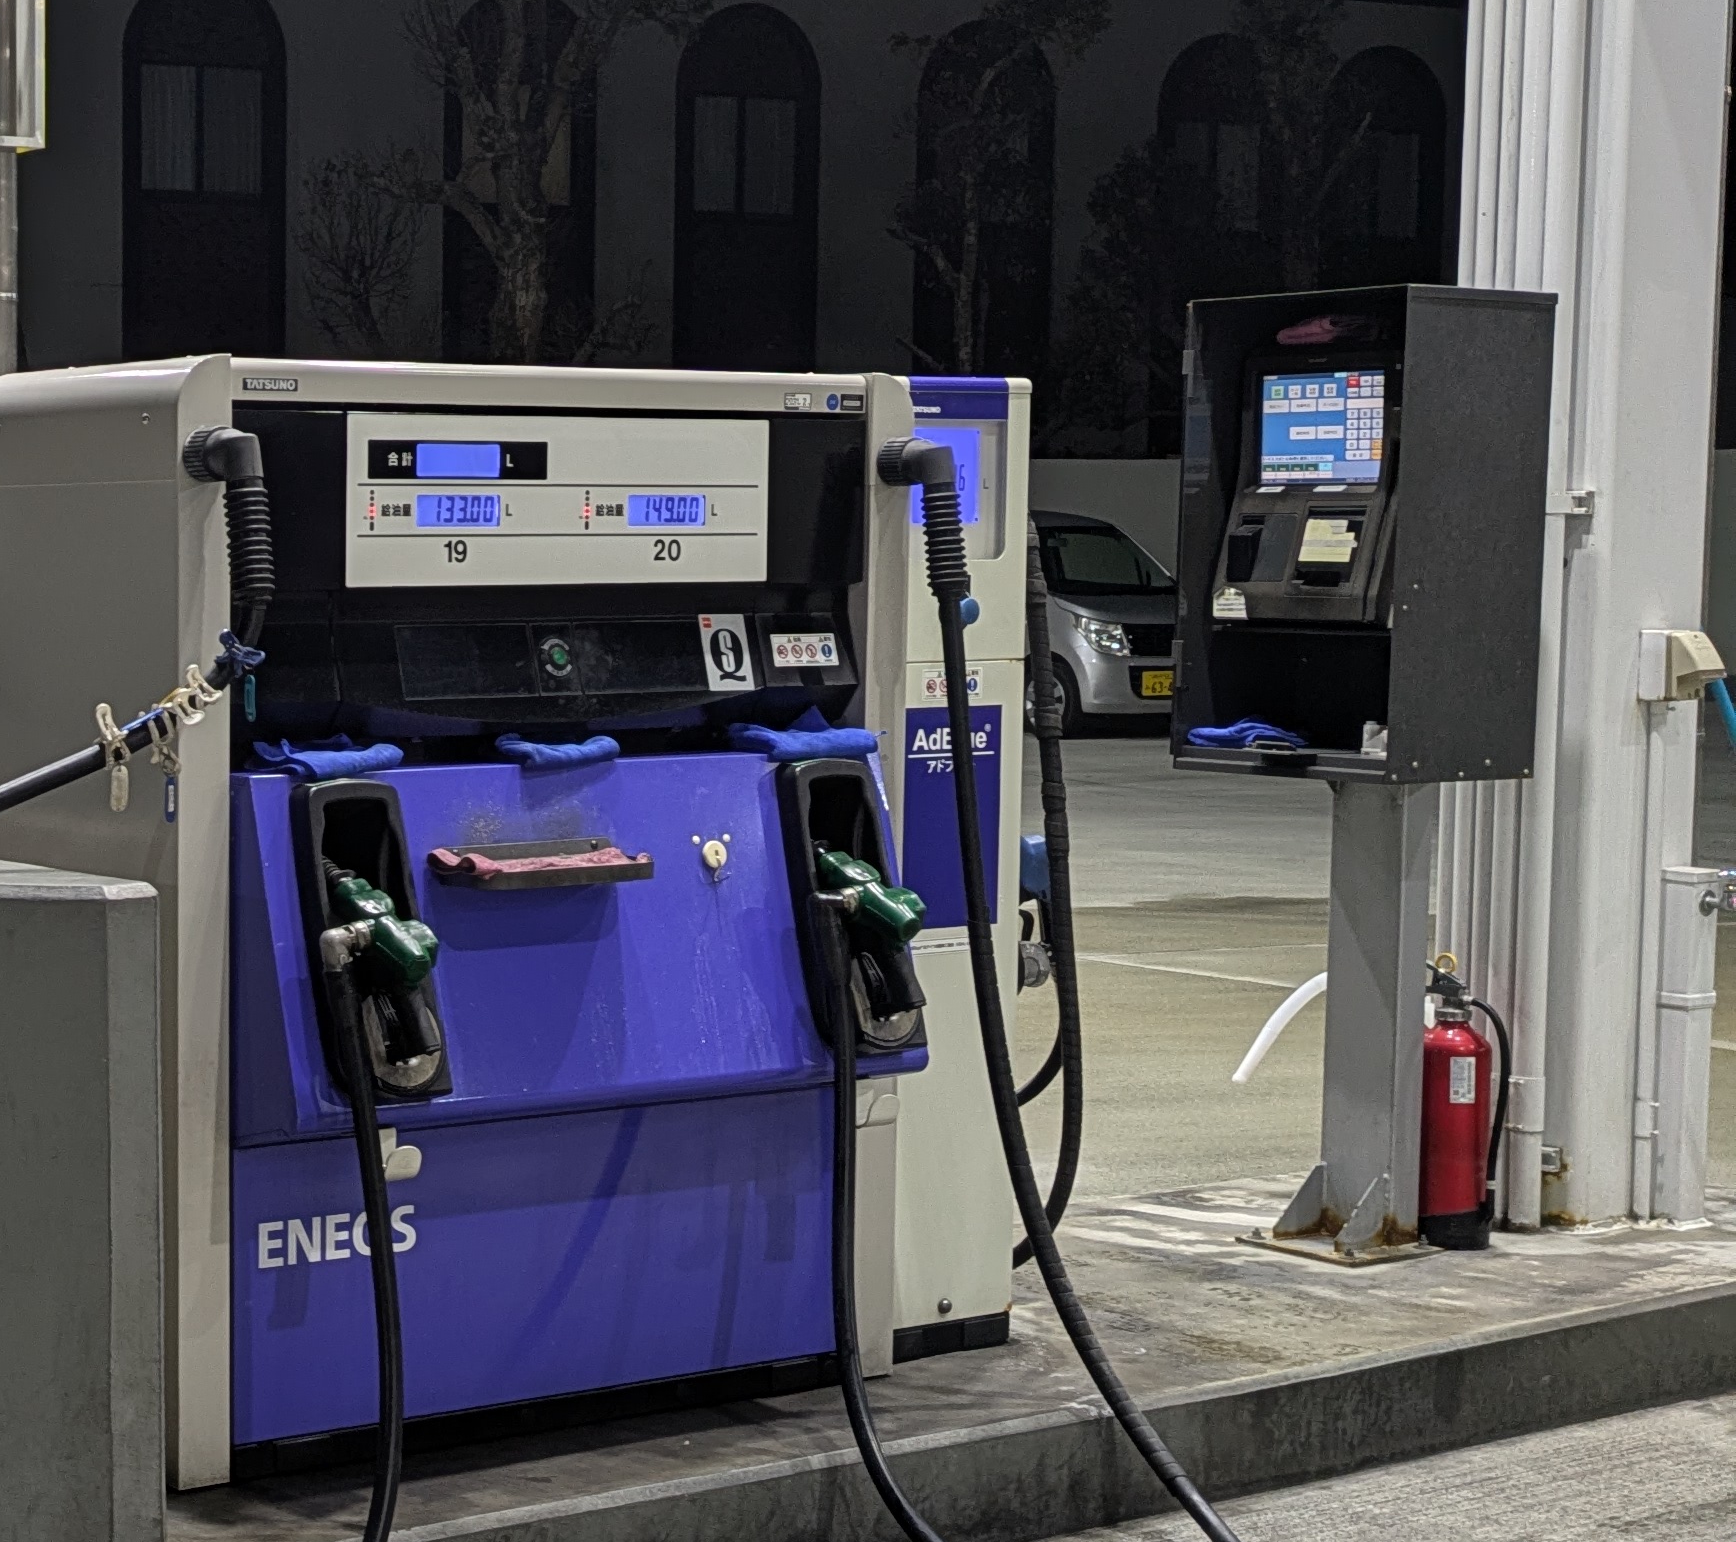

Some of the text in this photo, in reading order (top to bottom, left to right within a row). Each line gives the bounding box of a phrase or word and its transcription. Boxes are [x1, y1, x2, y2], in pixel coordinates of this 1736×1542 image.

[245, 378, 296, 391] TATSUNO
[506, 454, 513, 467] L
[436, 496, 495, 523] 133.00
[505, 505, 512, 516] L
[644, 496, 700, 523] 149.00
[711, 504, 718, 516] L
[443, 540, 468, 563] 19
[653, 539, 682, 562] 20
